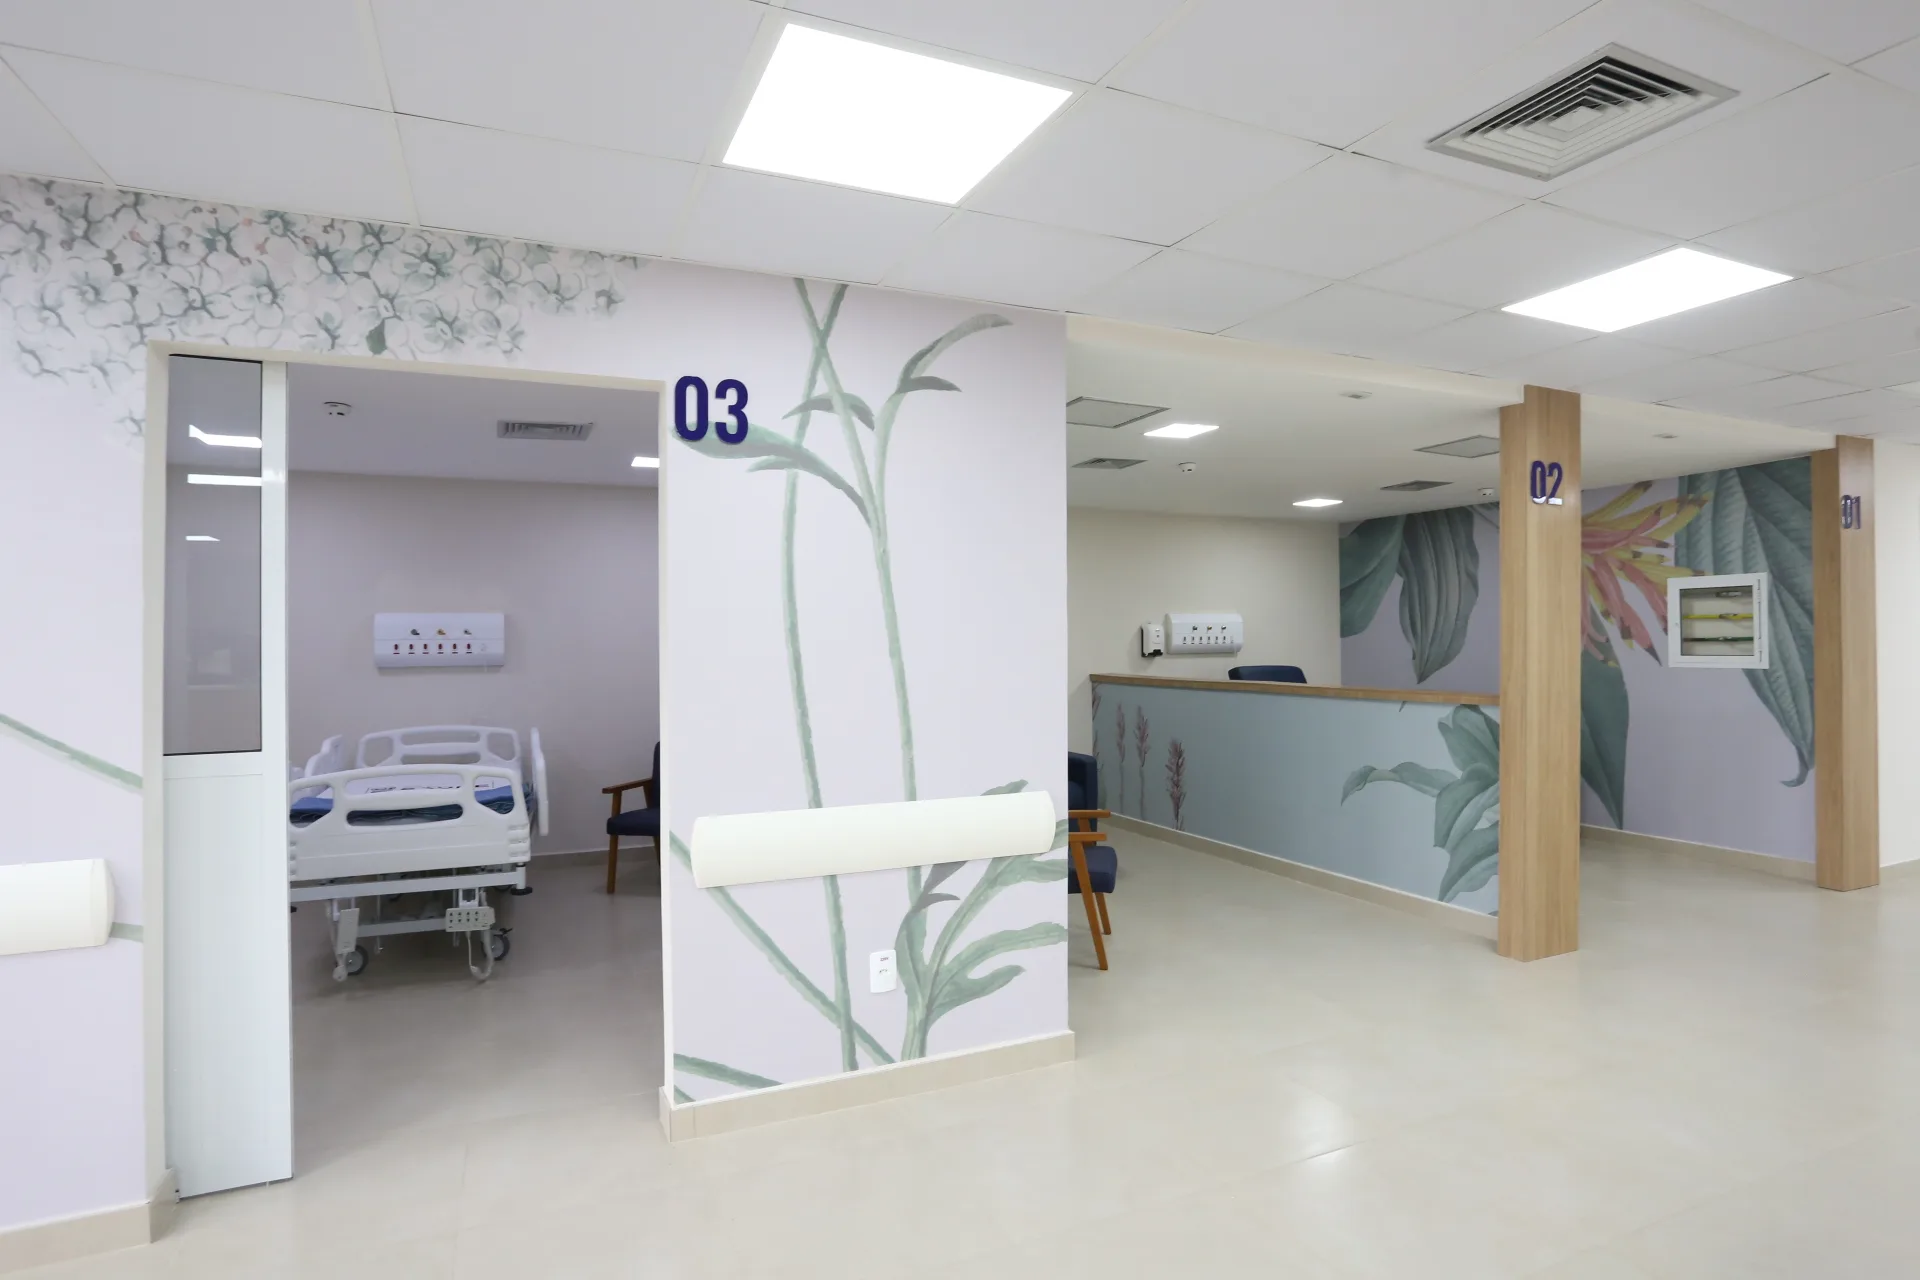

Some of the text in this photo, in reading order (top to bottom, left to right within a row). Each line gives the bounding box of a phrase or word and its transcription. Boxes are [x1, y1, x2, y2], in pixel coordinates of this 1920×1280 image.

[674, 375, 748, 445] 03
[1530, 460, 1563, 505] 02
[1841, 494, 1861, 530] 01
